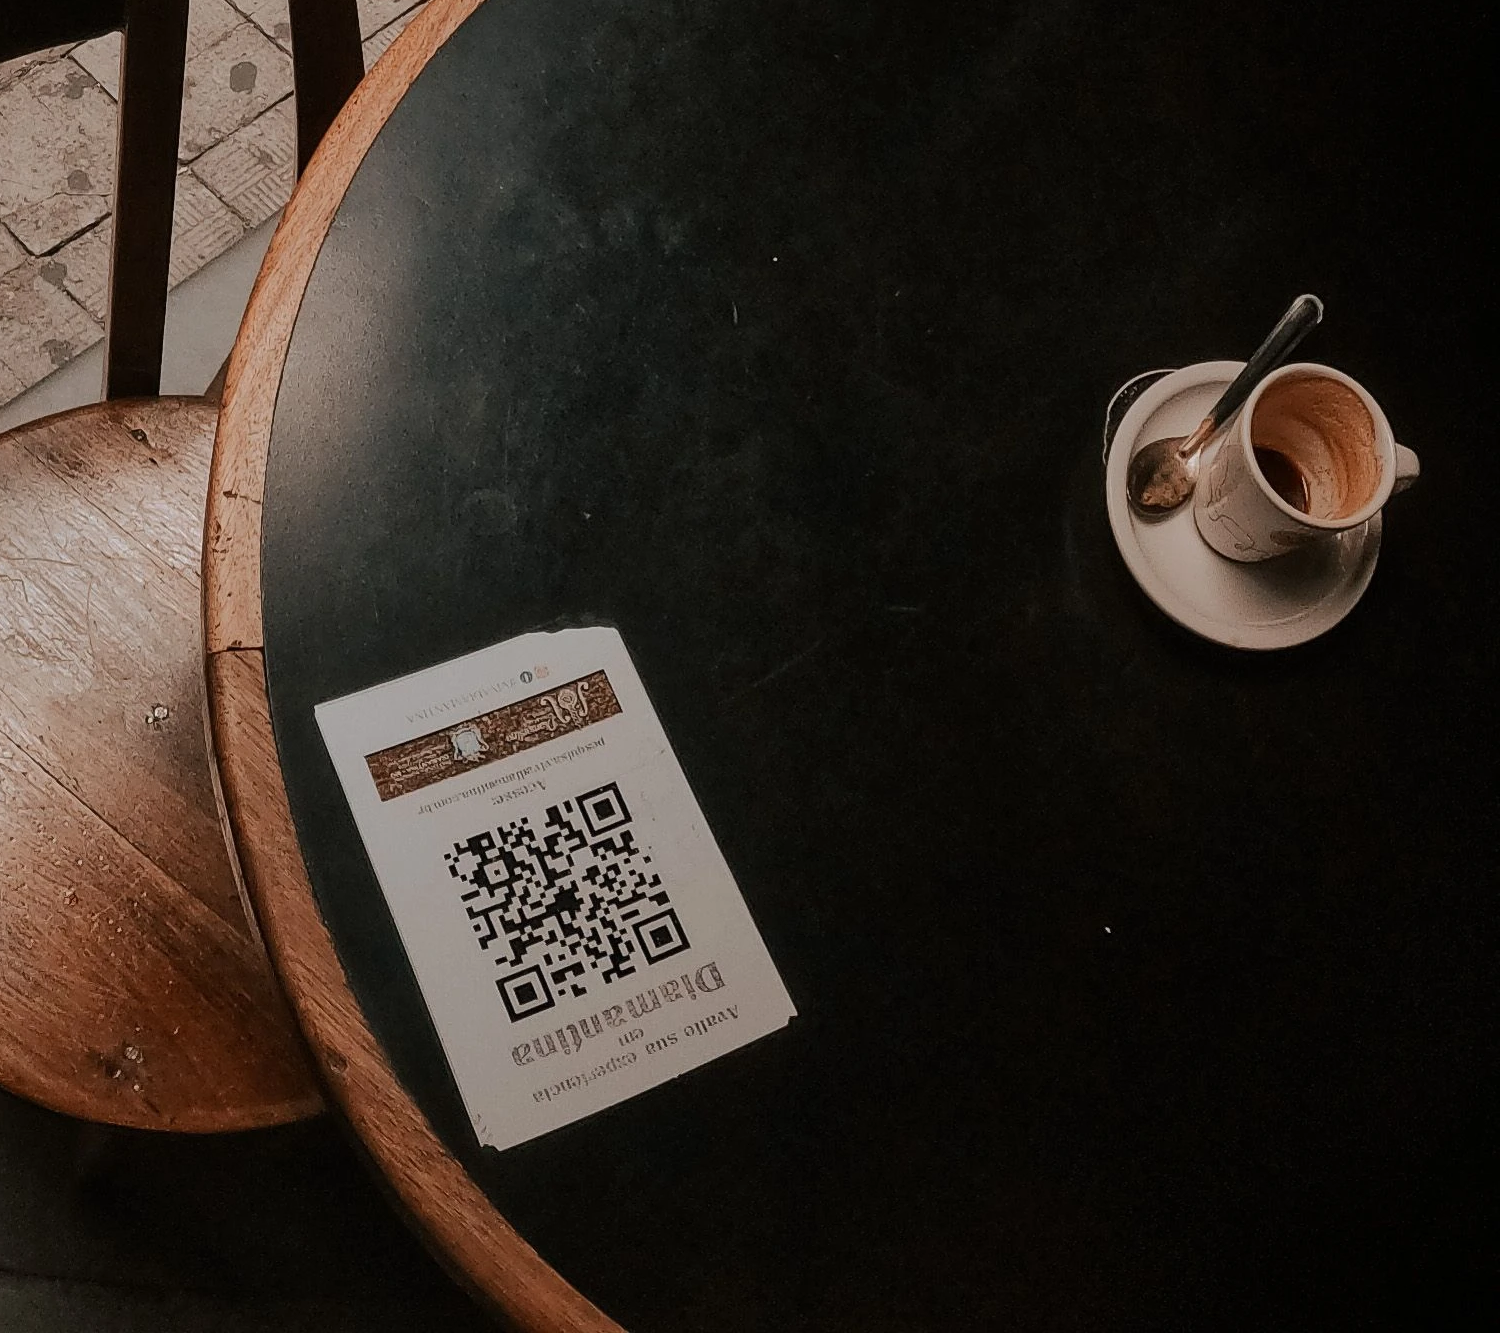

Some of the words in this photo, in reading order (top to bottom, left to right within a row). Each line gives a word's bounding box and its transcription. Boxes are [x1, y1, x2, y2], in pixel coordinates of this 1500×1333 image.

[508, 960, 726, 1068] Diamantina
[617, 1027, 645, 1046] em
[644, 1032, 679, 1055] sua
